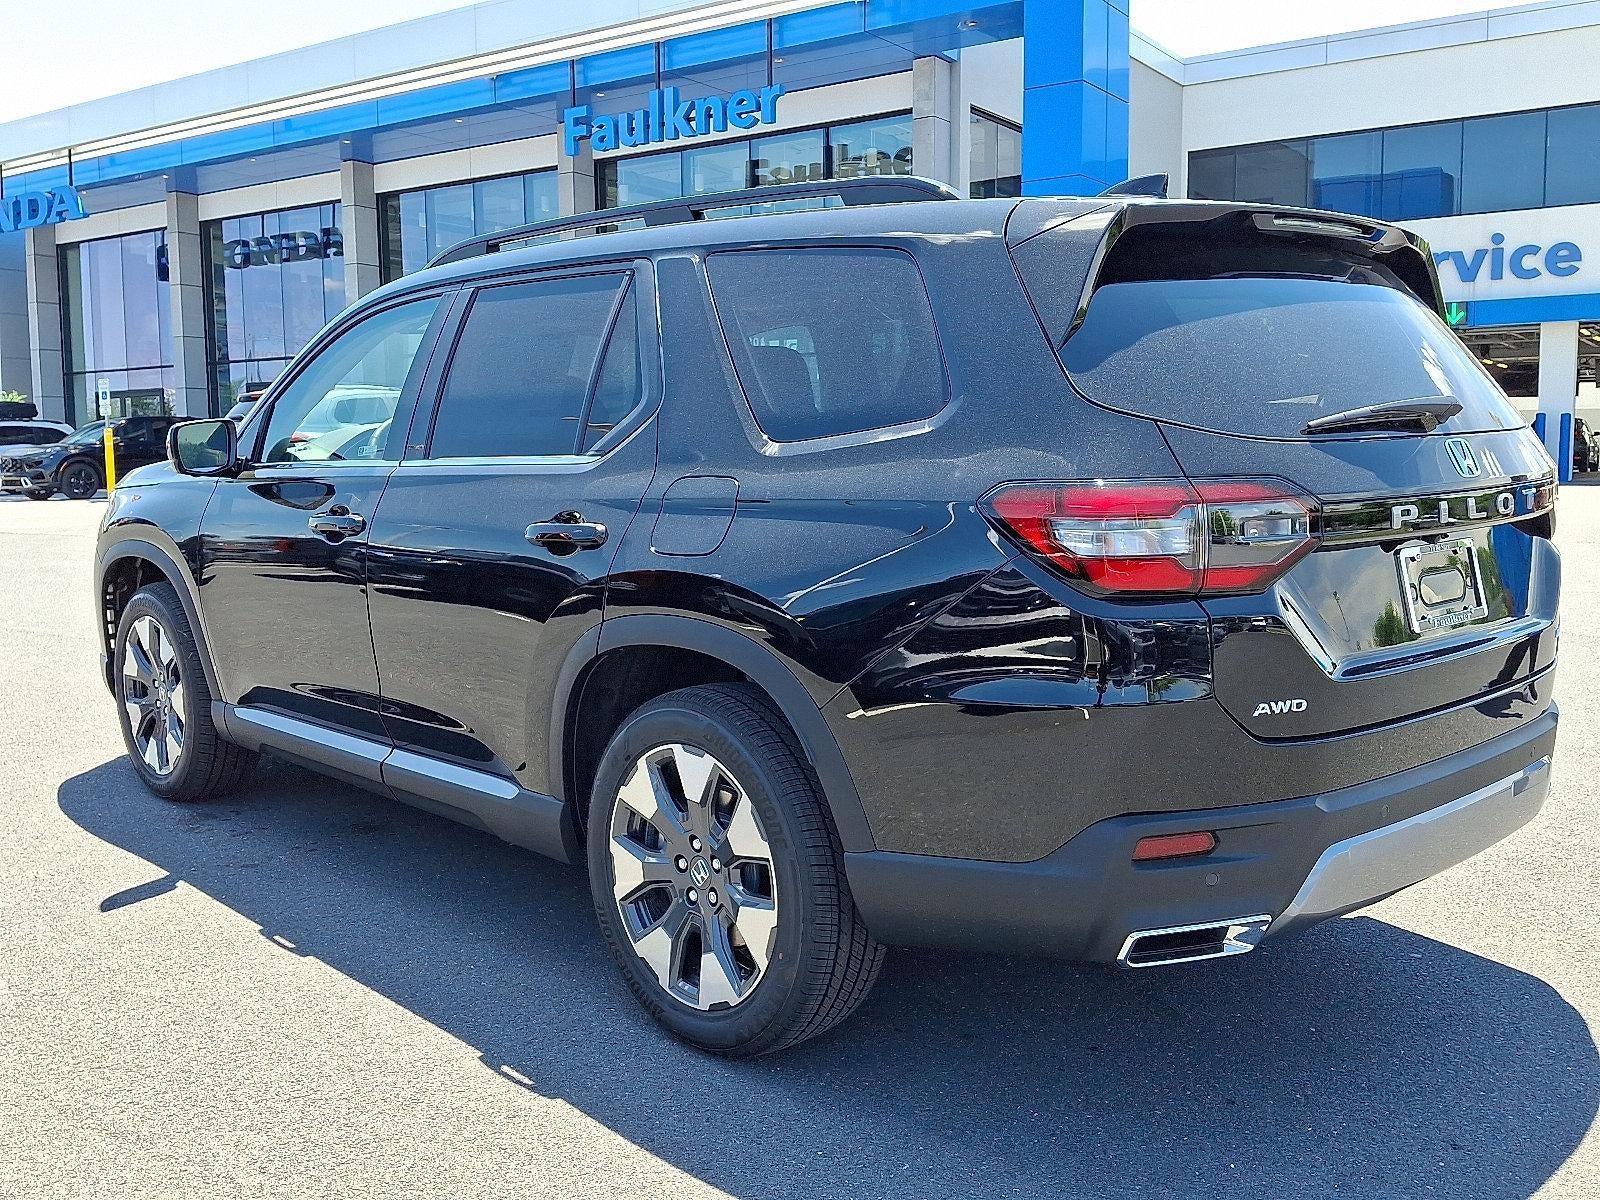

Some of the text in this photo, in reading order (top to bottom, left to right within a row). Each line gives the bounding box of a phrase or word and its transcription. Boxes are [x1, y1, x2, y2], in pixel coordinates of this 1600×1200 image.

[563, 83, 786, 157] Faulkner
[1391, 487, 1537, 530] PILOT
[1252, 698, 1308, 717] AWD
